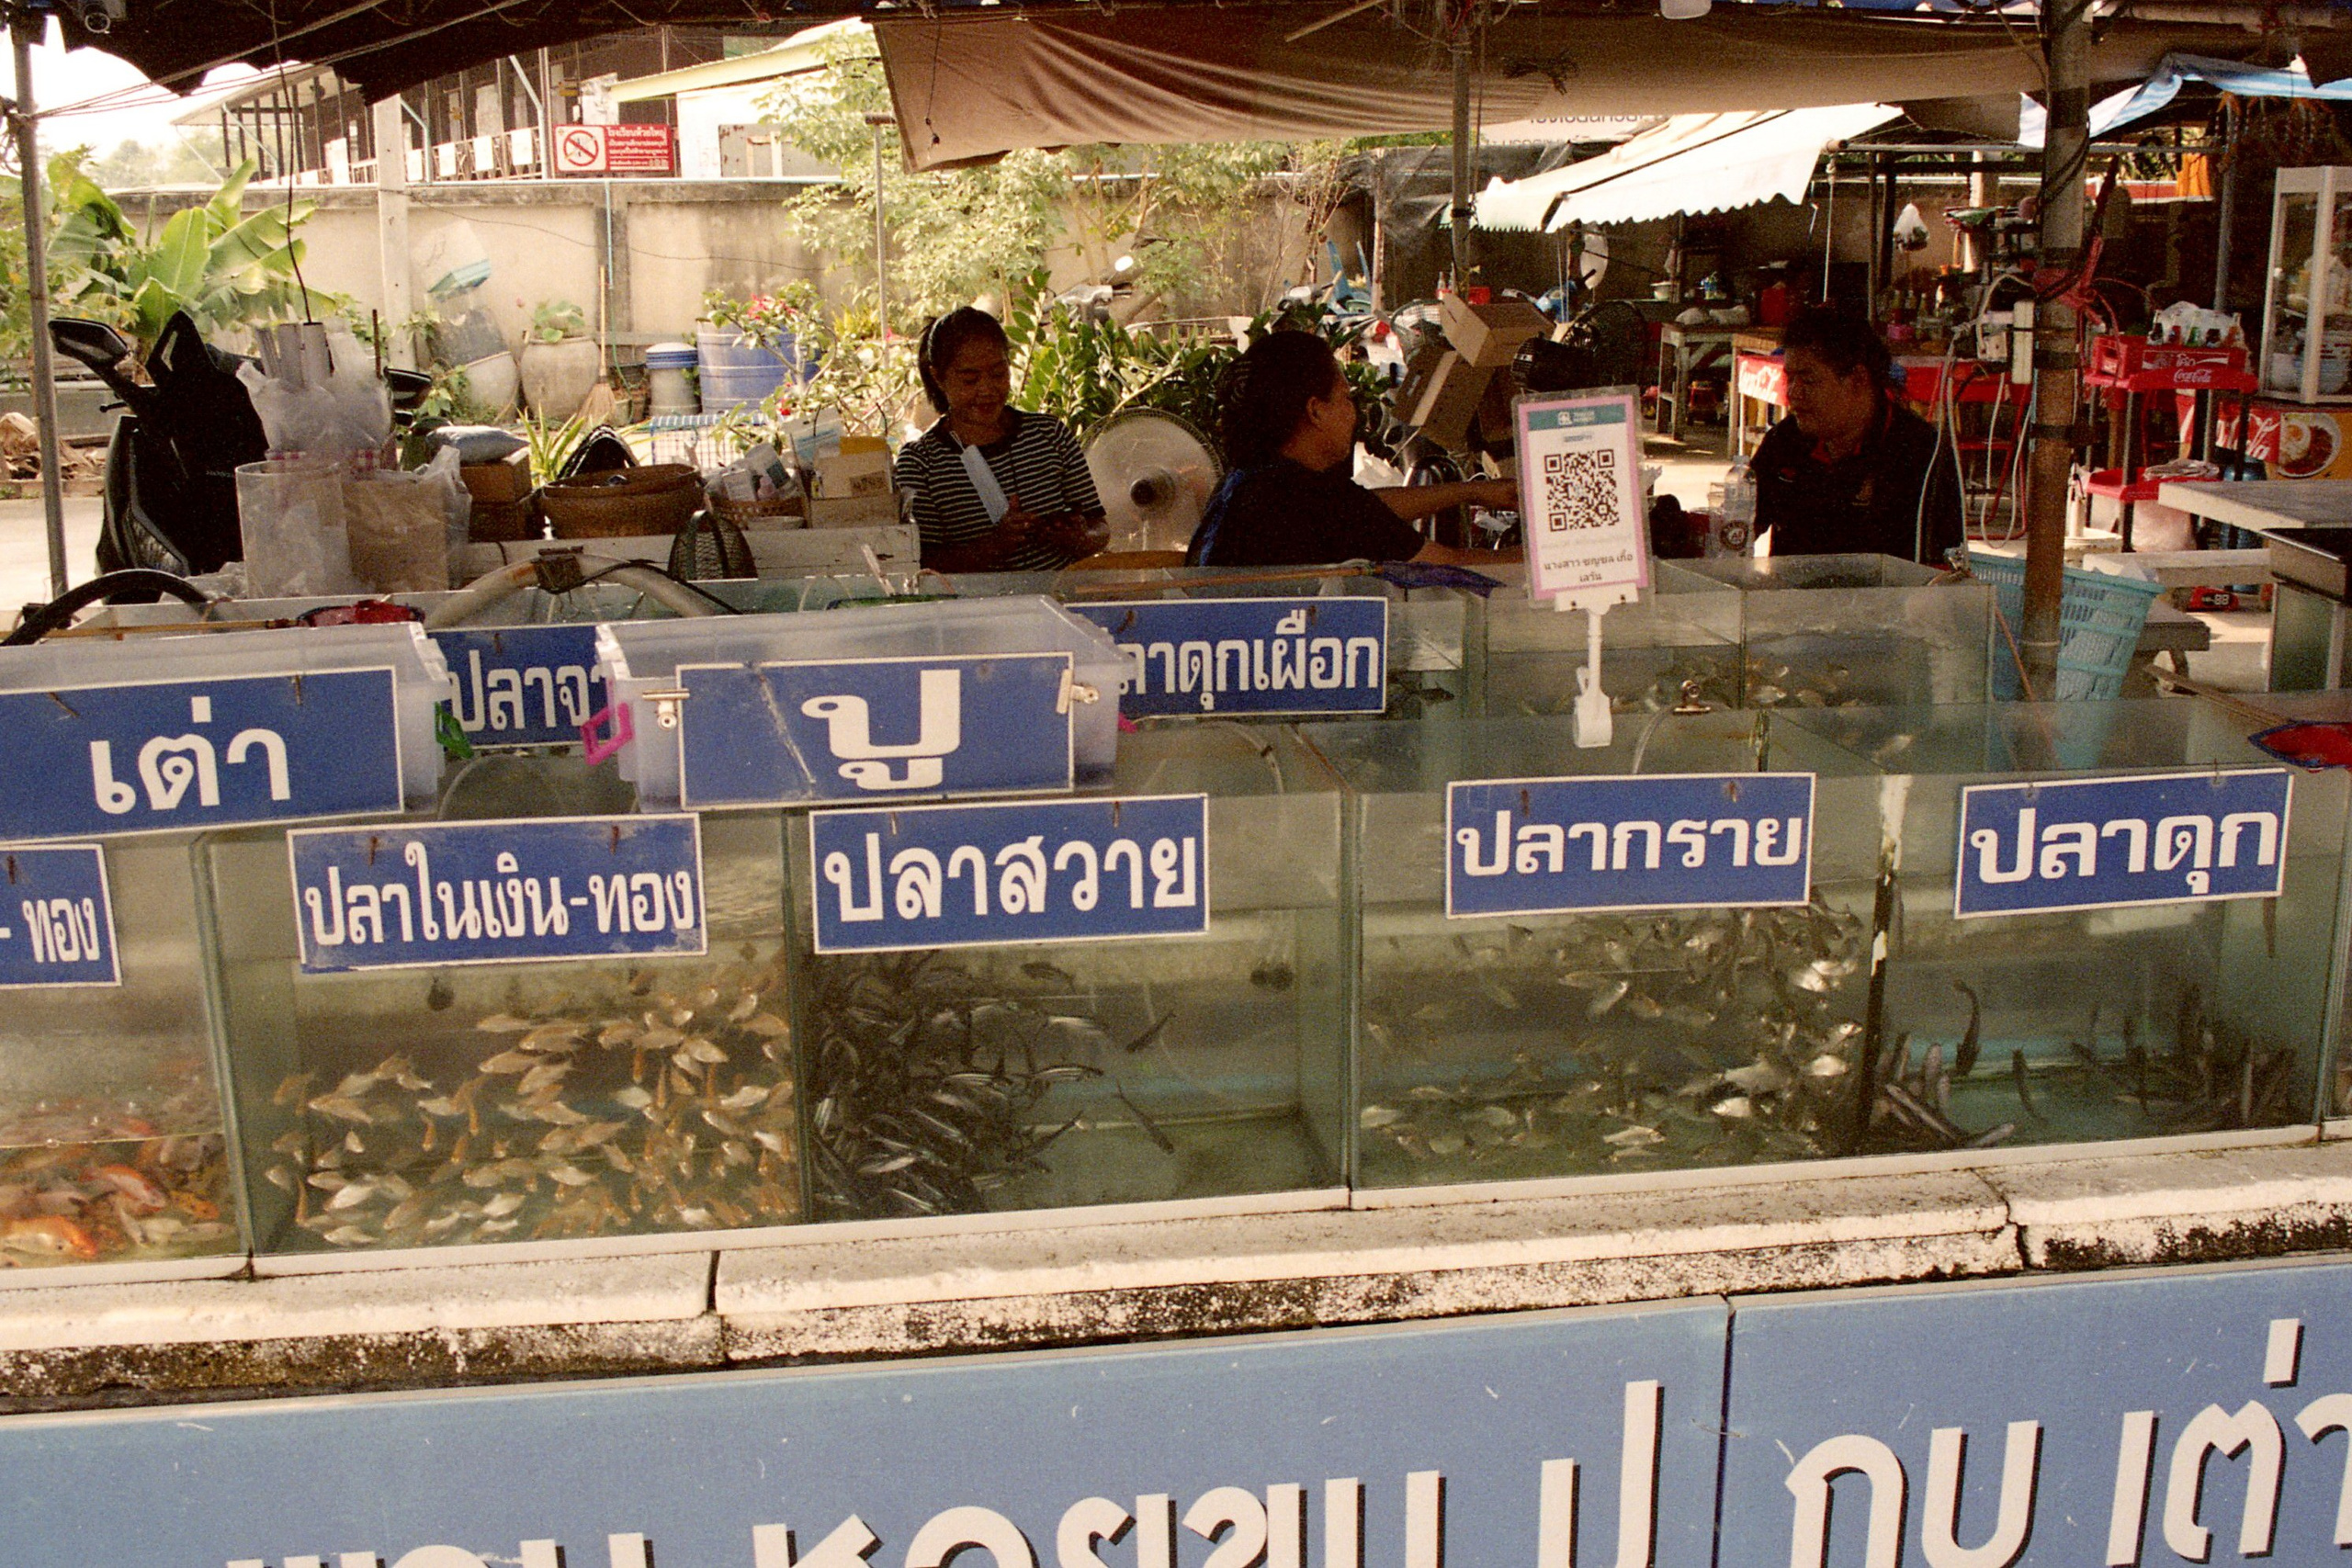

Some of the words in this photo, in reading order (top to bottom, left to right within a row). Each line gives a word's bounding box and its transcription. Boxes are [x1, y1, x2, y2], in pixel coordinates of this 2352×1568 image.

[1114, 610, 1379, 710] ลาดุกเผือก
[89, 696, 290, 815] เต่า
[801, 669, 960, 790] ปู
[304, 840, 695, 946] ปลาในเงิน-ทอง
[823, 831, 1197, 922] ปลาสวาย
[1455, 810, 1804, 877] ปลากราย
[1970, 808, 2278, 895] ปลาดุก
